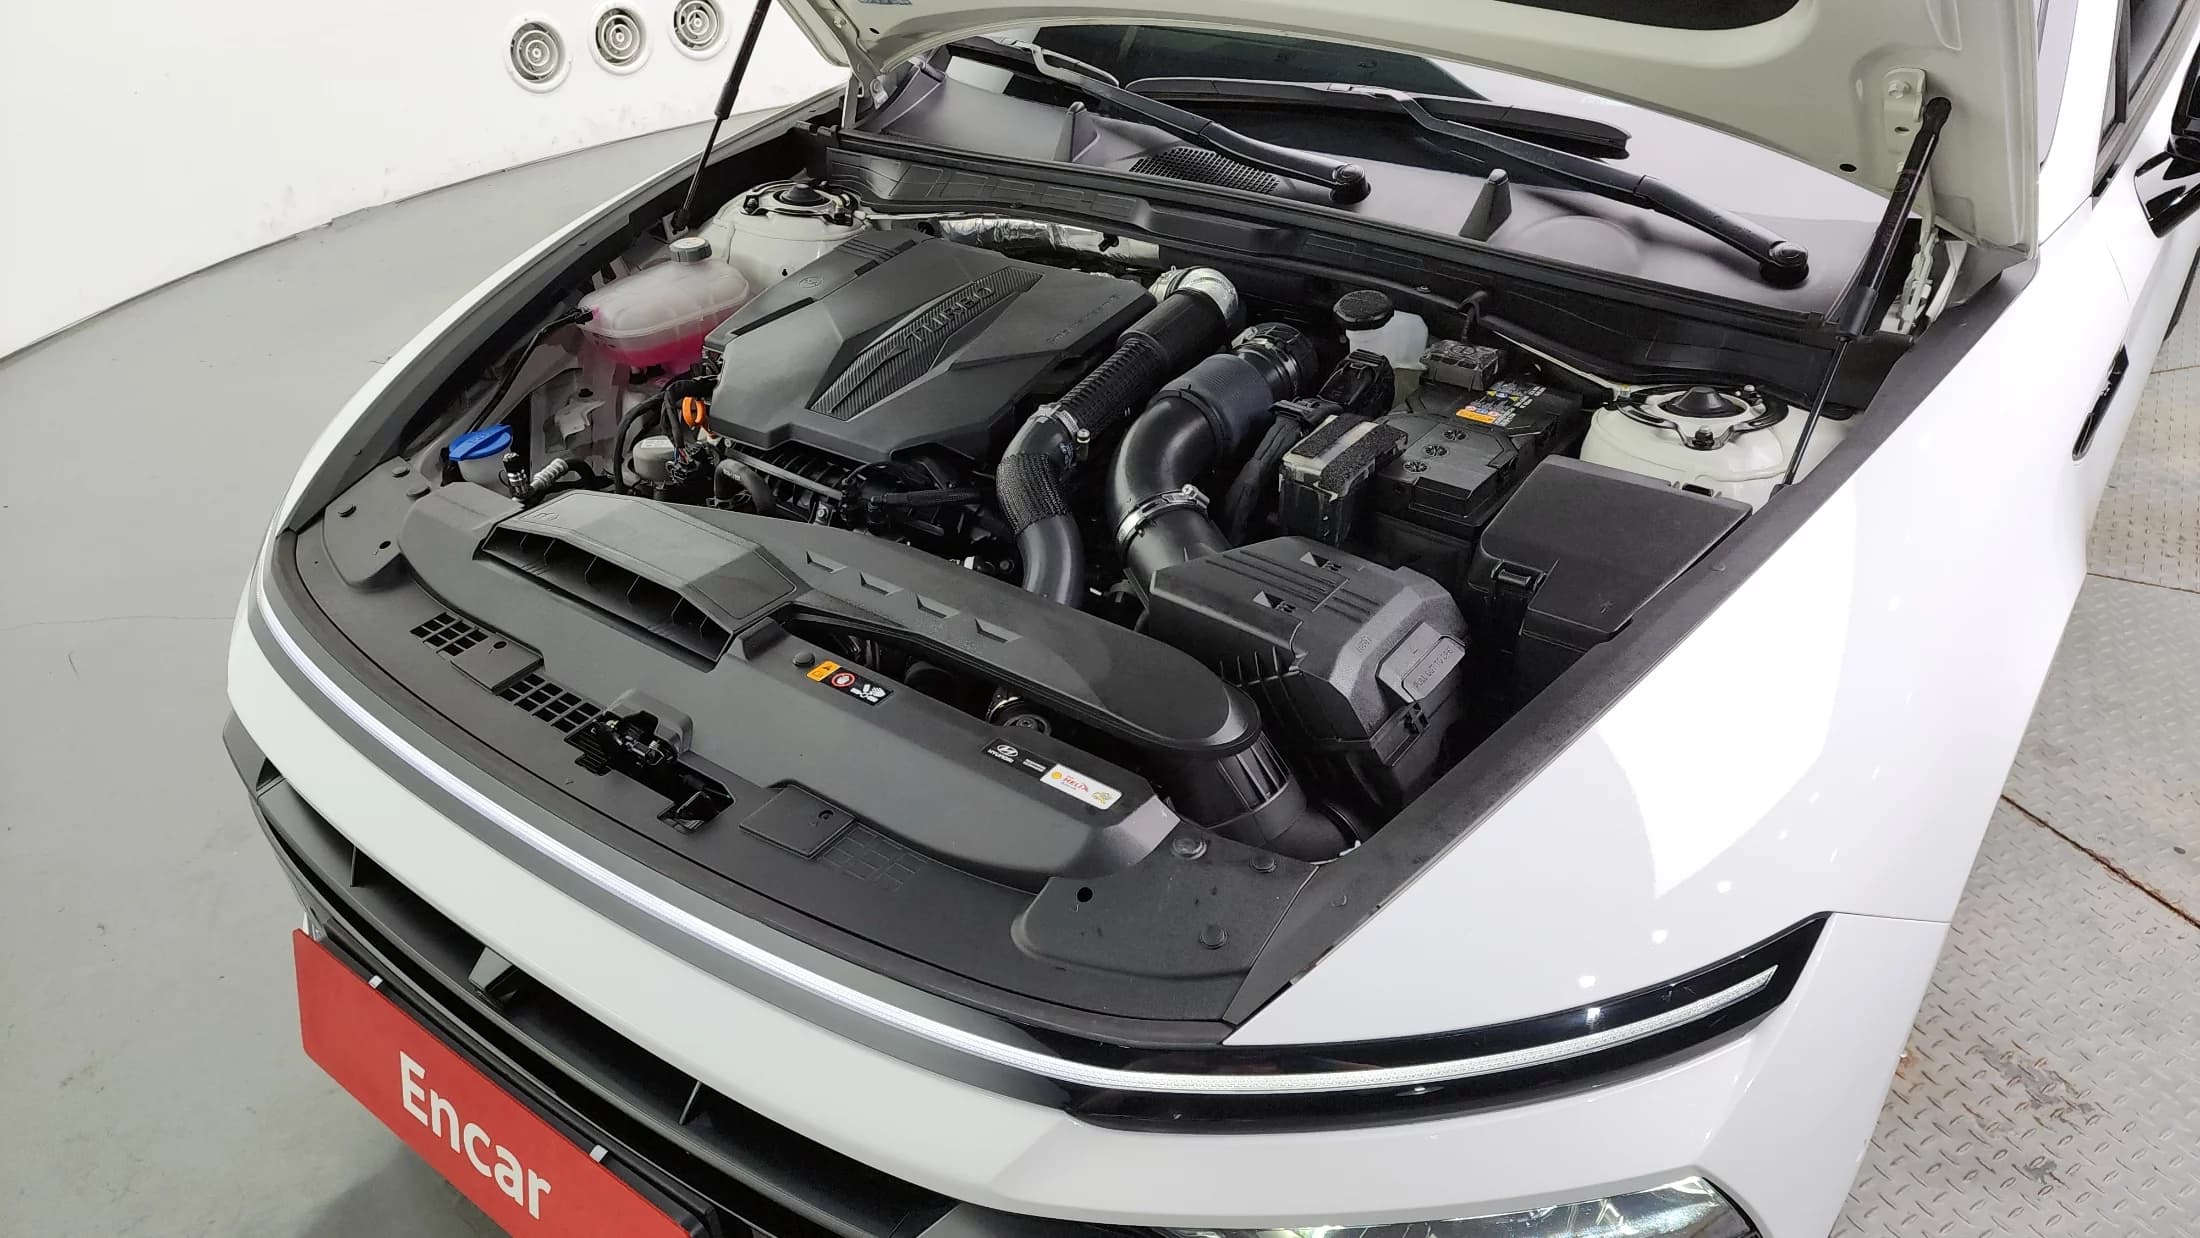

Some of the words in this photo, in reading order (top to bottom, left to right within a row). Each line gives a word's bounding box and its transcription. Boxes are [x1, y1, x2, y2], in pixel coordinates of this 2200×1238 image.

[904, 286, 993, 342] TURBO
[1063, 777, 1088, 792] HELIX
[400, 1050, 552, 1220] Encar
